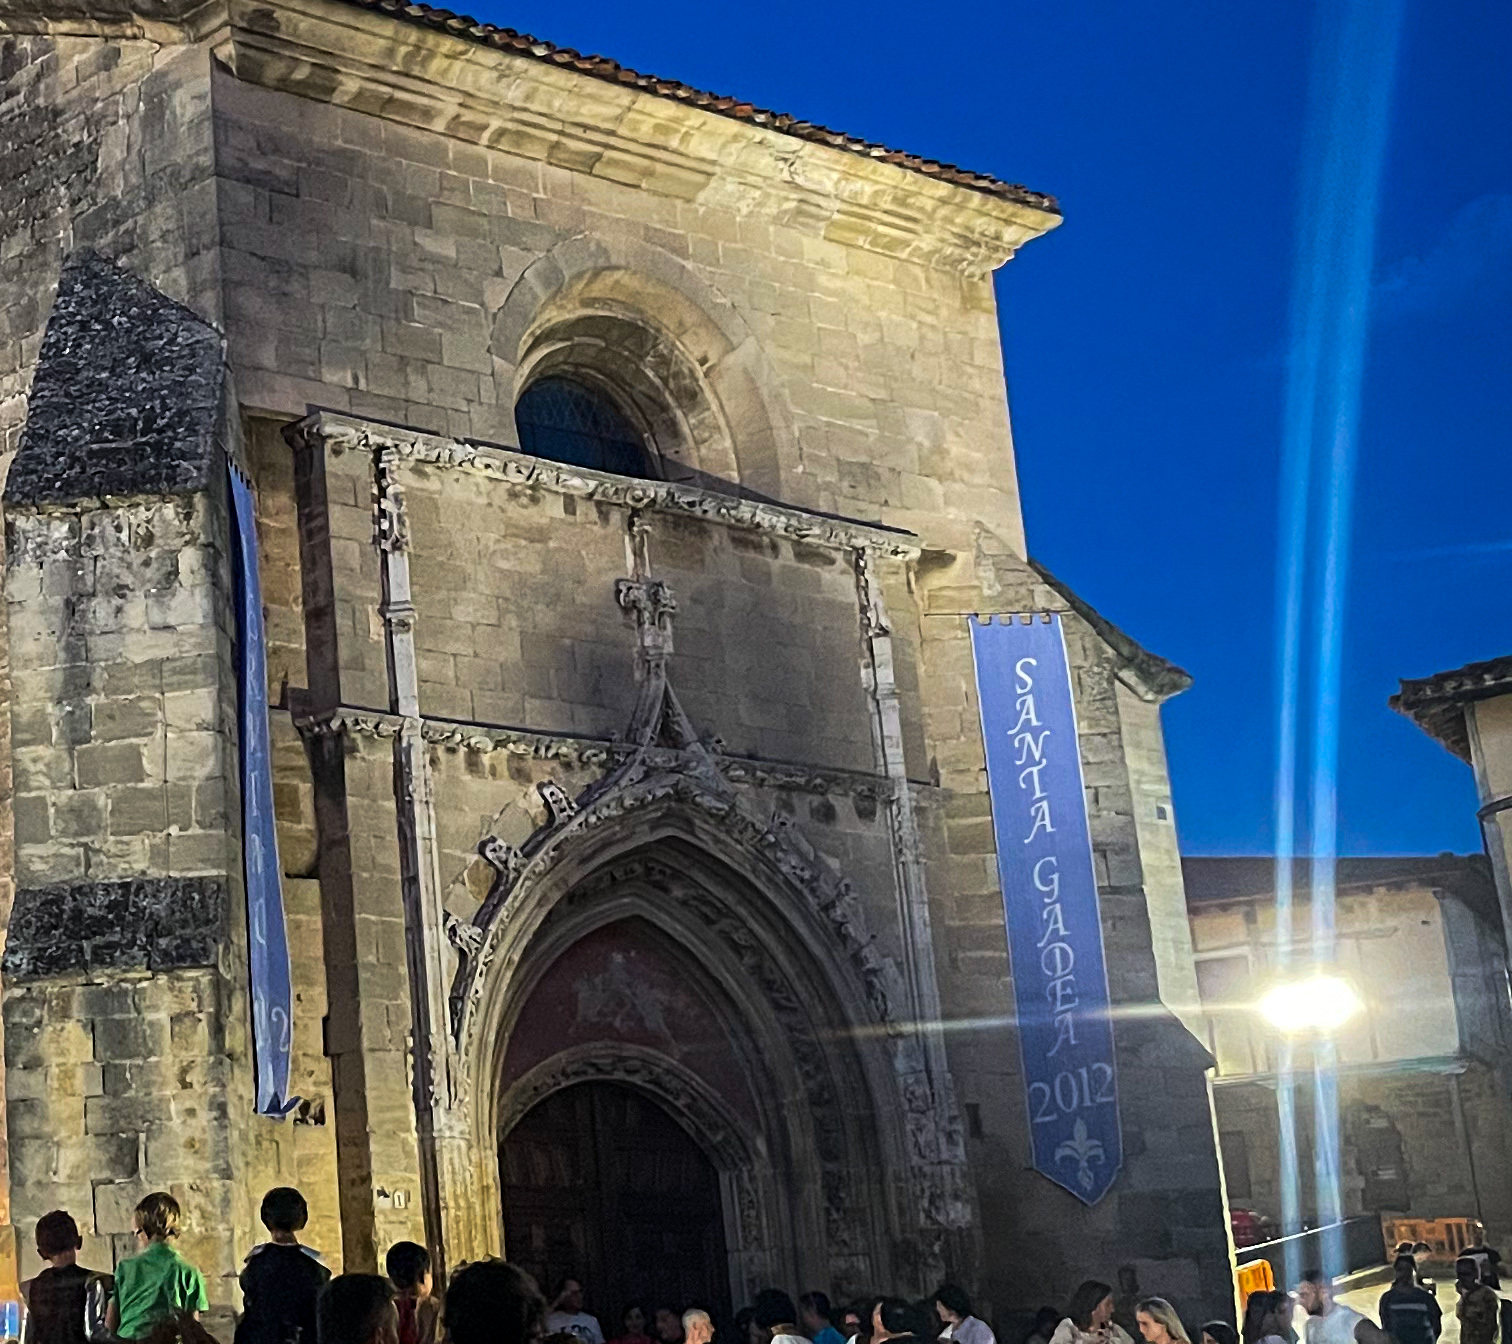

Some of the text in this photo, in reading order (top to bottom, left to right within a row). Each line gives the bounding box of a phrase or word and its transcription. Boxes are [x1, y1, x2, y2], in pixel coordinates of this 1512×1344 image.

[1007, 657, 1079, 1057] SANTA GADEA
[1029, 1063, 1114, 1124] 2012
